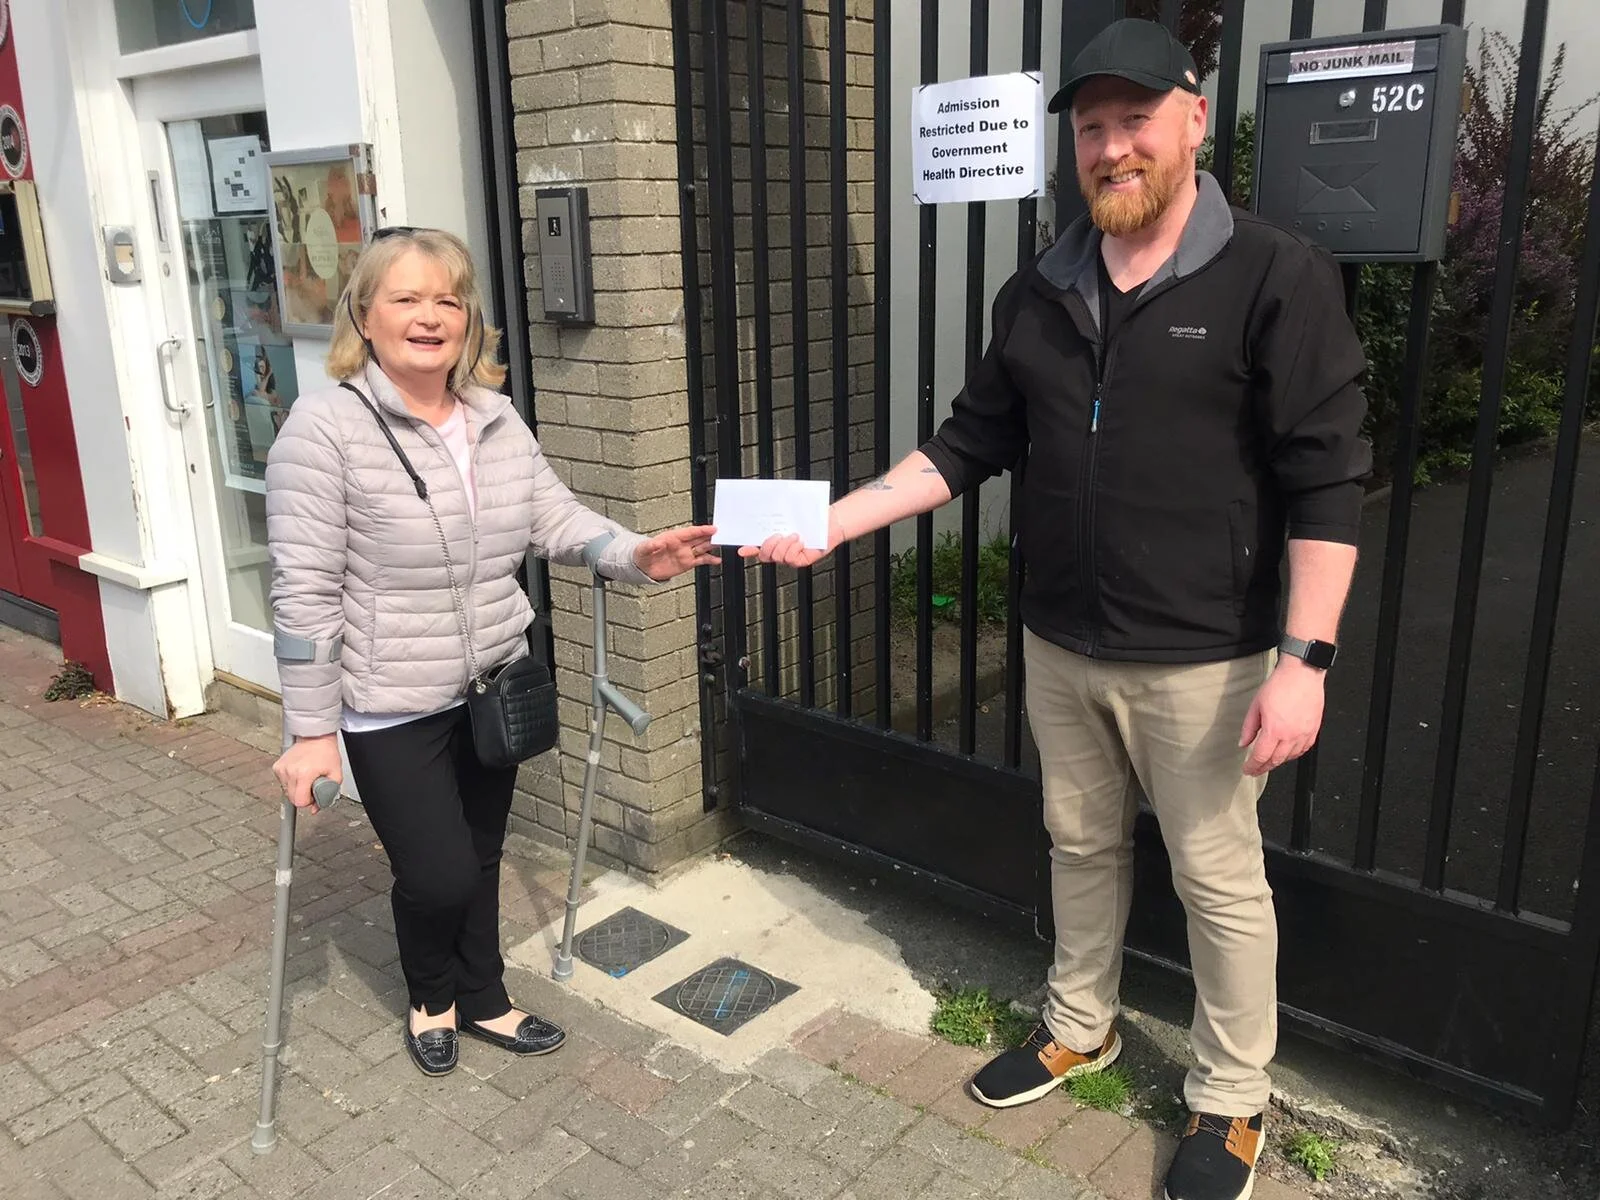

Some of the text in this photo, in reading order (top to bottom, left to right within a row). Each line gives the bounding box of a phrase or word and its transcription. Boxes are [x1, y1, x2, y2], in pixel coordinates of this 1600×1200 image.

[1298, 51, 1405, 72] NO JUNK MAIL
[937, 97, 1000, 114] Admission
[1371, 83, 1425, 113] 52C
[919, 118, 1029, 138] Restricted Due to
[931, 142, 1008, 159] Government
[922, 164, 1024, 181] Health Directive
